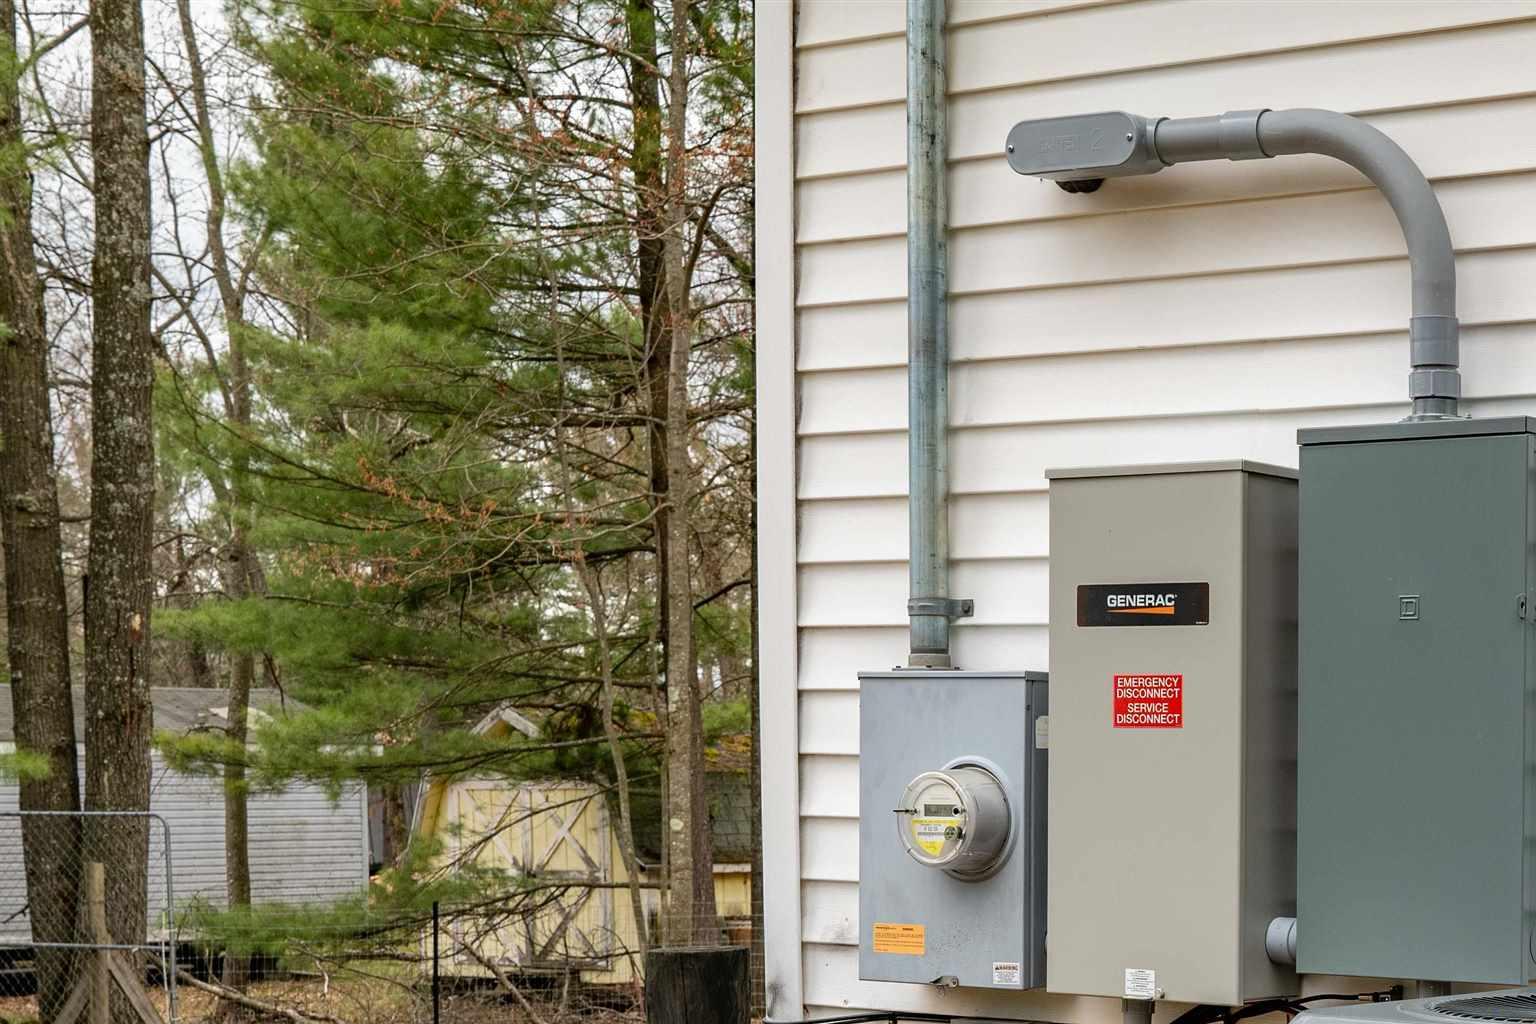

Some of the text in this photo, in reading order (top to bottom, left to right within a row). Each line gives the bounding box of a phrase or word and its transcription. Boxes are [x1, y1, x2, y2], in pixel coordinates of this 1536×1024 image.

[1107, 594, 1175, 607] GENERAC
[1117, 677, 1179, 688] EMERGENCY
[1116, 688, 1180, 698] DISCONNECT
[1127, 702, 1169, 713] SERVICE
[1116, 713, 1180, 724] DISCONNECT
